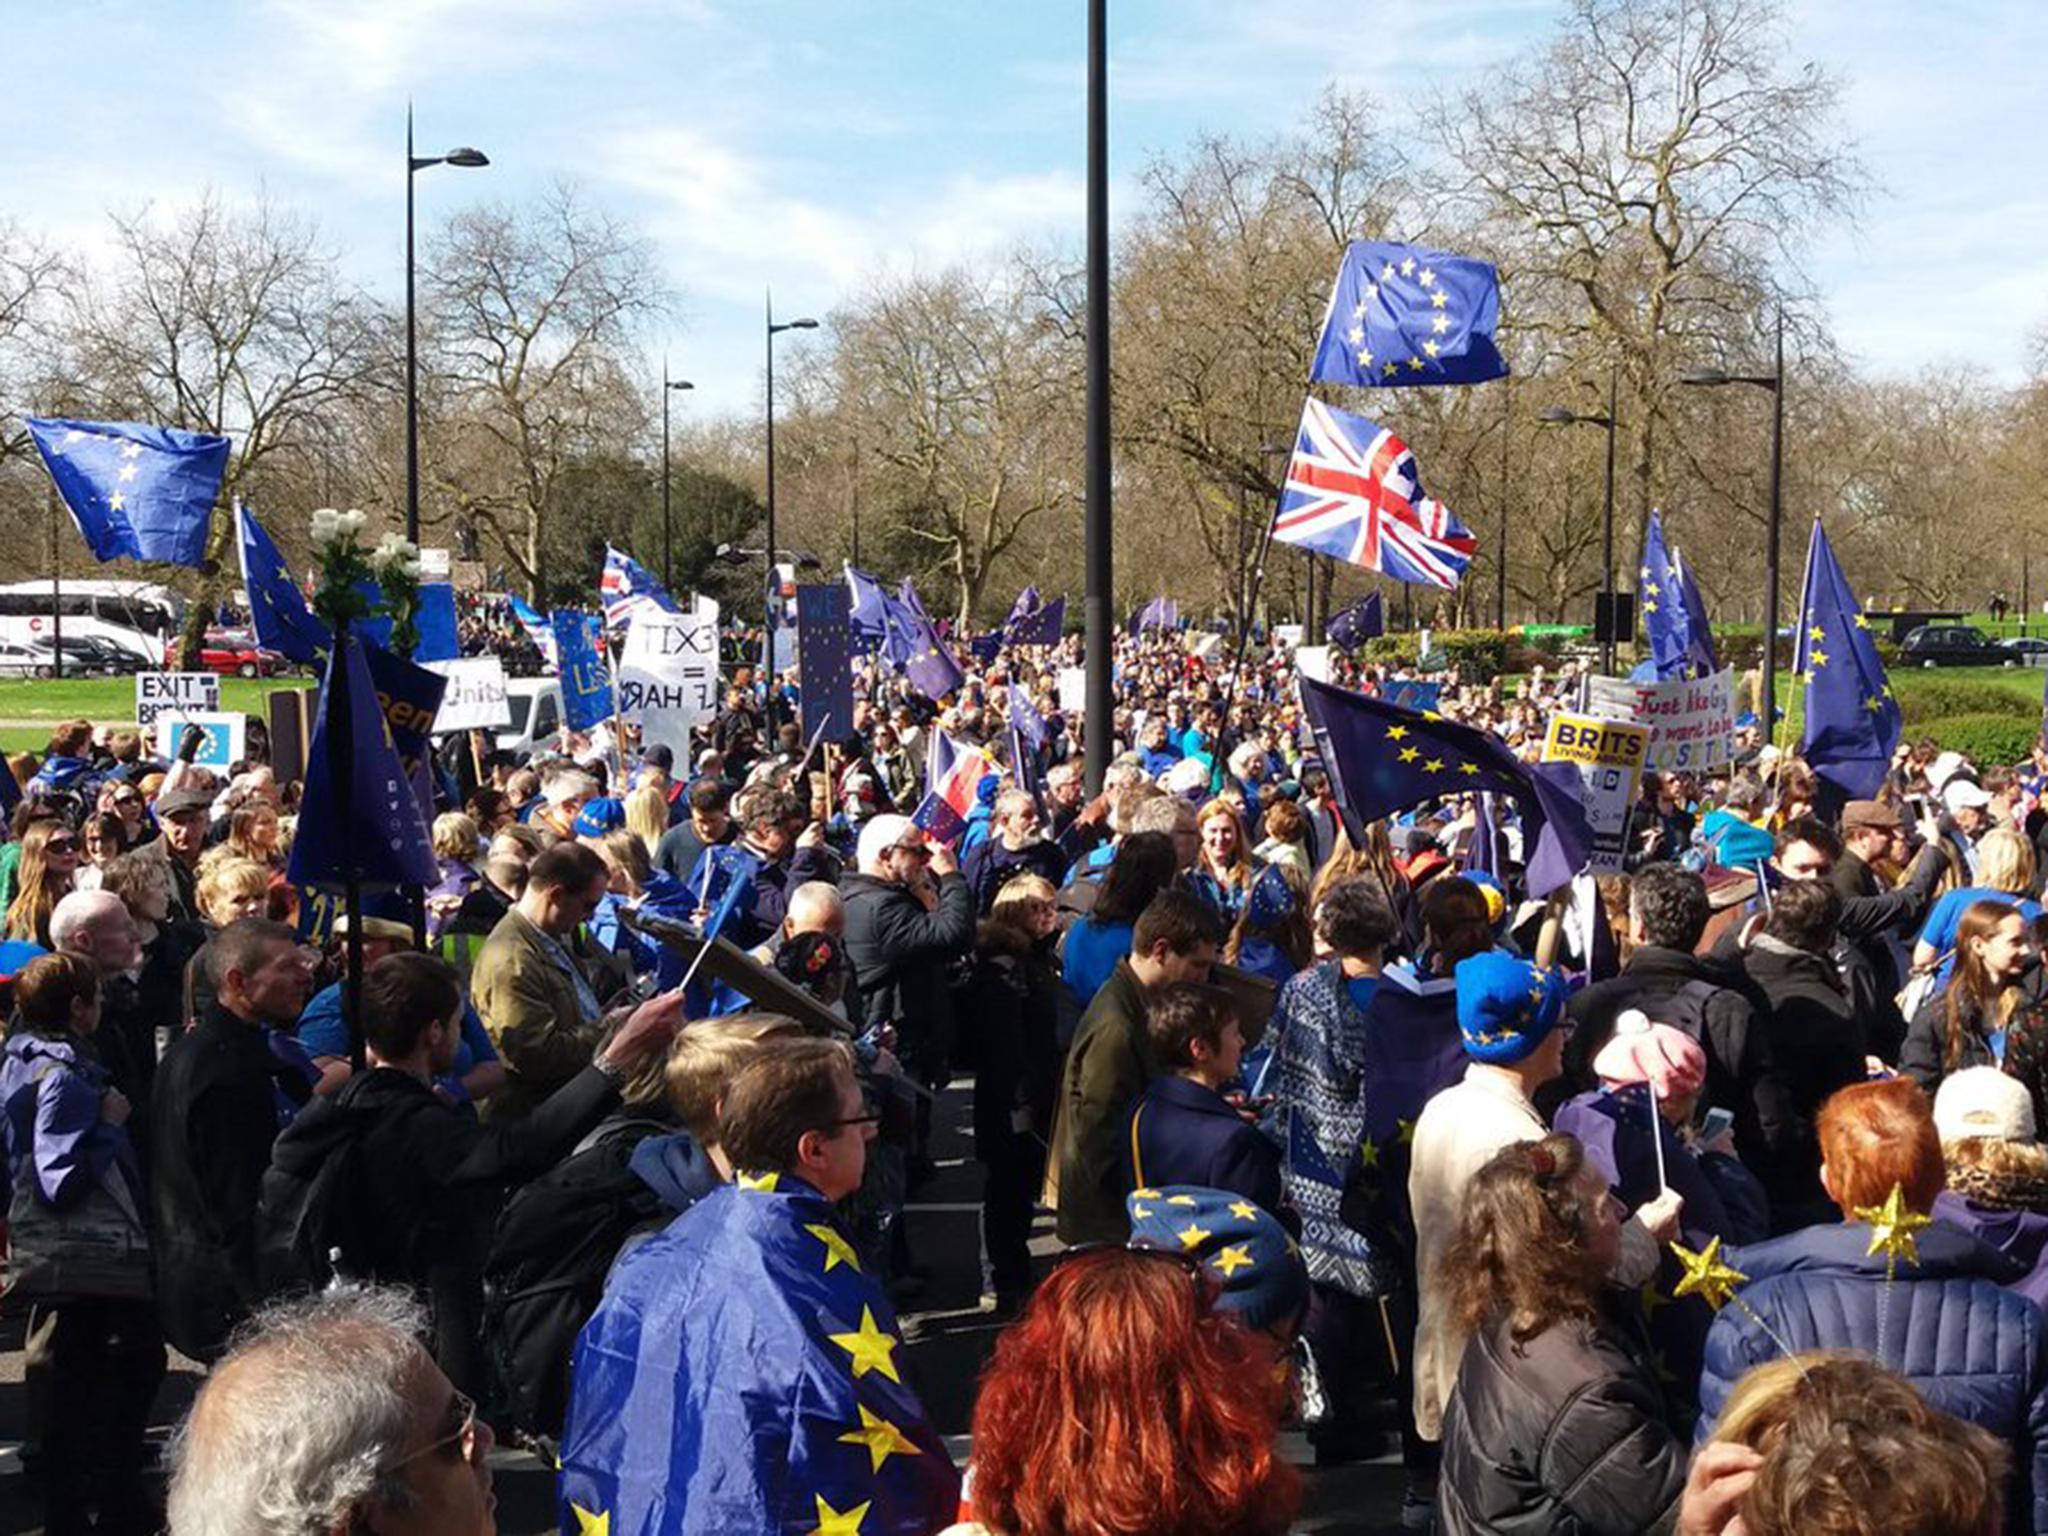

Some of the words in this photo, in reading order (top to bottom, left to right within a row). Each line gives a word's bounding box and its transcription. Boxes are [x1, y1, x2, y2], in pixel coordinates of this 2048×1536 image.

[142, 676, 194, 698] EXIT
[1633, 690, 1680, 715] Just
[1556, 723, 1642, 755] BRITS
[1553, 746, 1592, 761] LIVING
